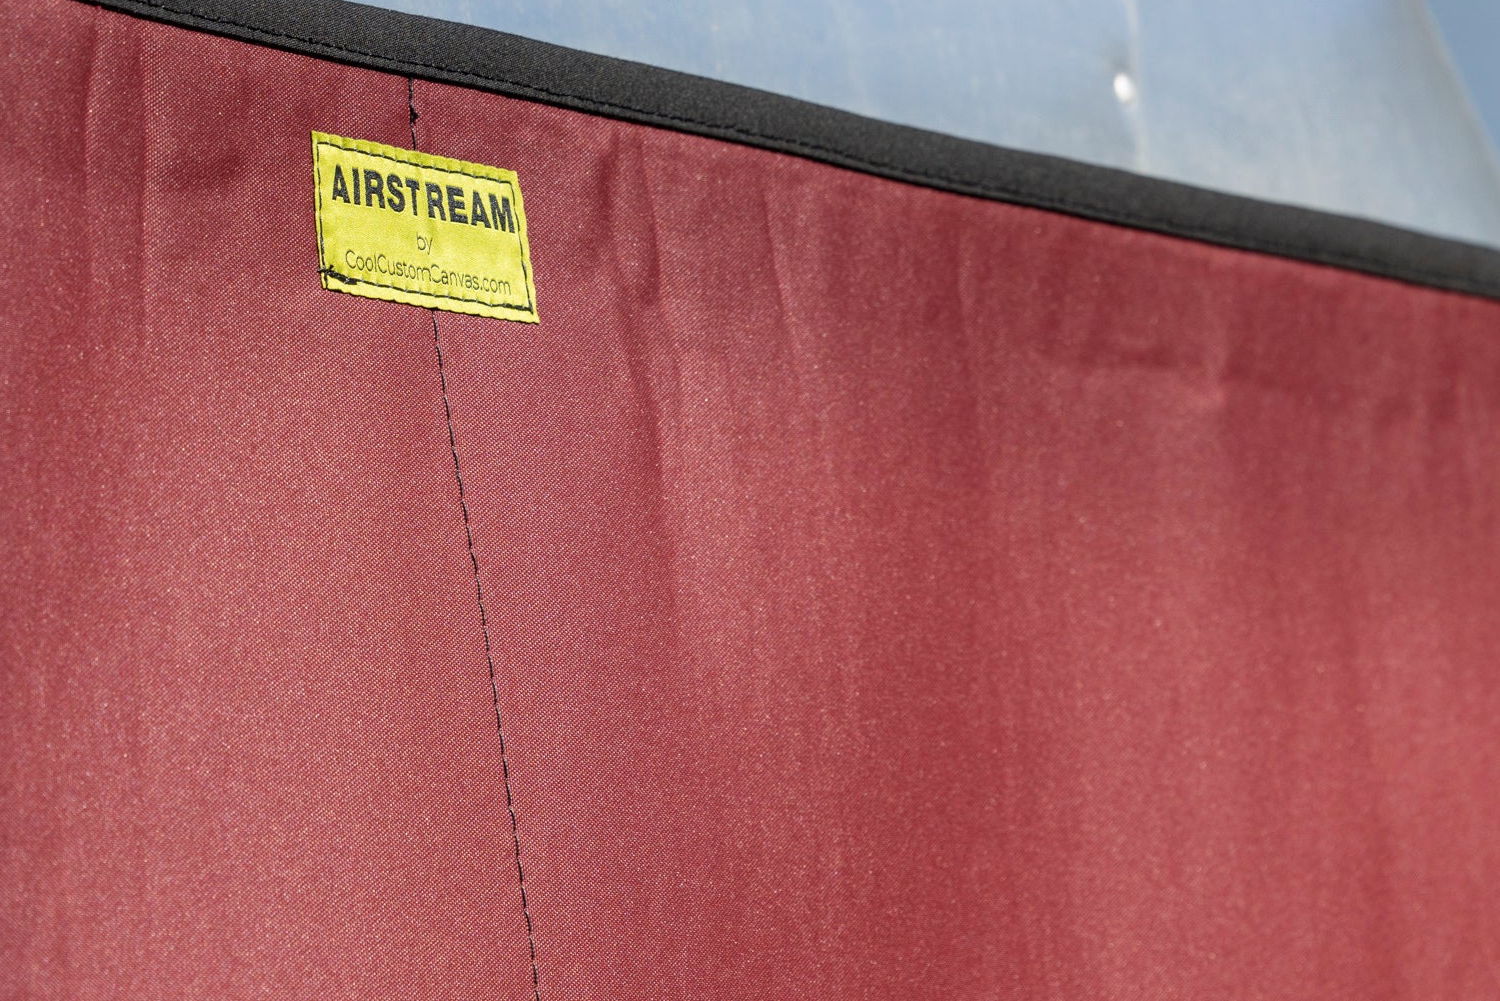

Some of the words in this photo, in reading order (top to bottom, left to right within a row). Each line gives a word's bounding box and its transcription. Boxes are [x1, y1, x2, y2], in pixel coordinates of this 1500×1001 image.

[331, 164, 515, 234] AIRSTREAM
[416, 232, 433, 255] by
[345, 249, 512, 296] CoolCustomCanvas.com
